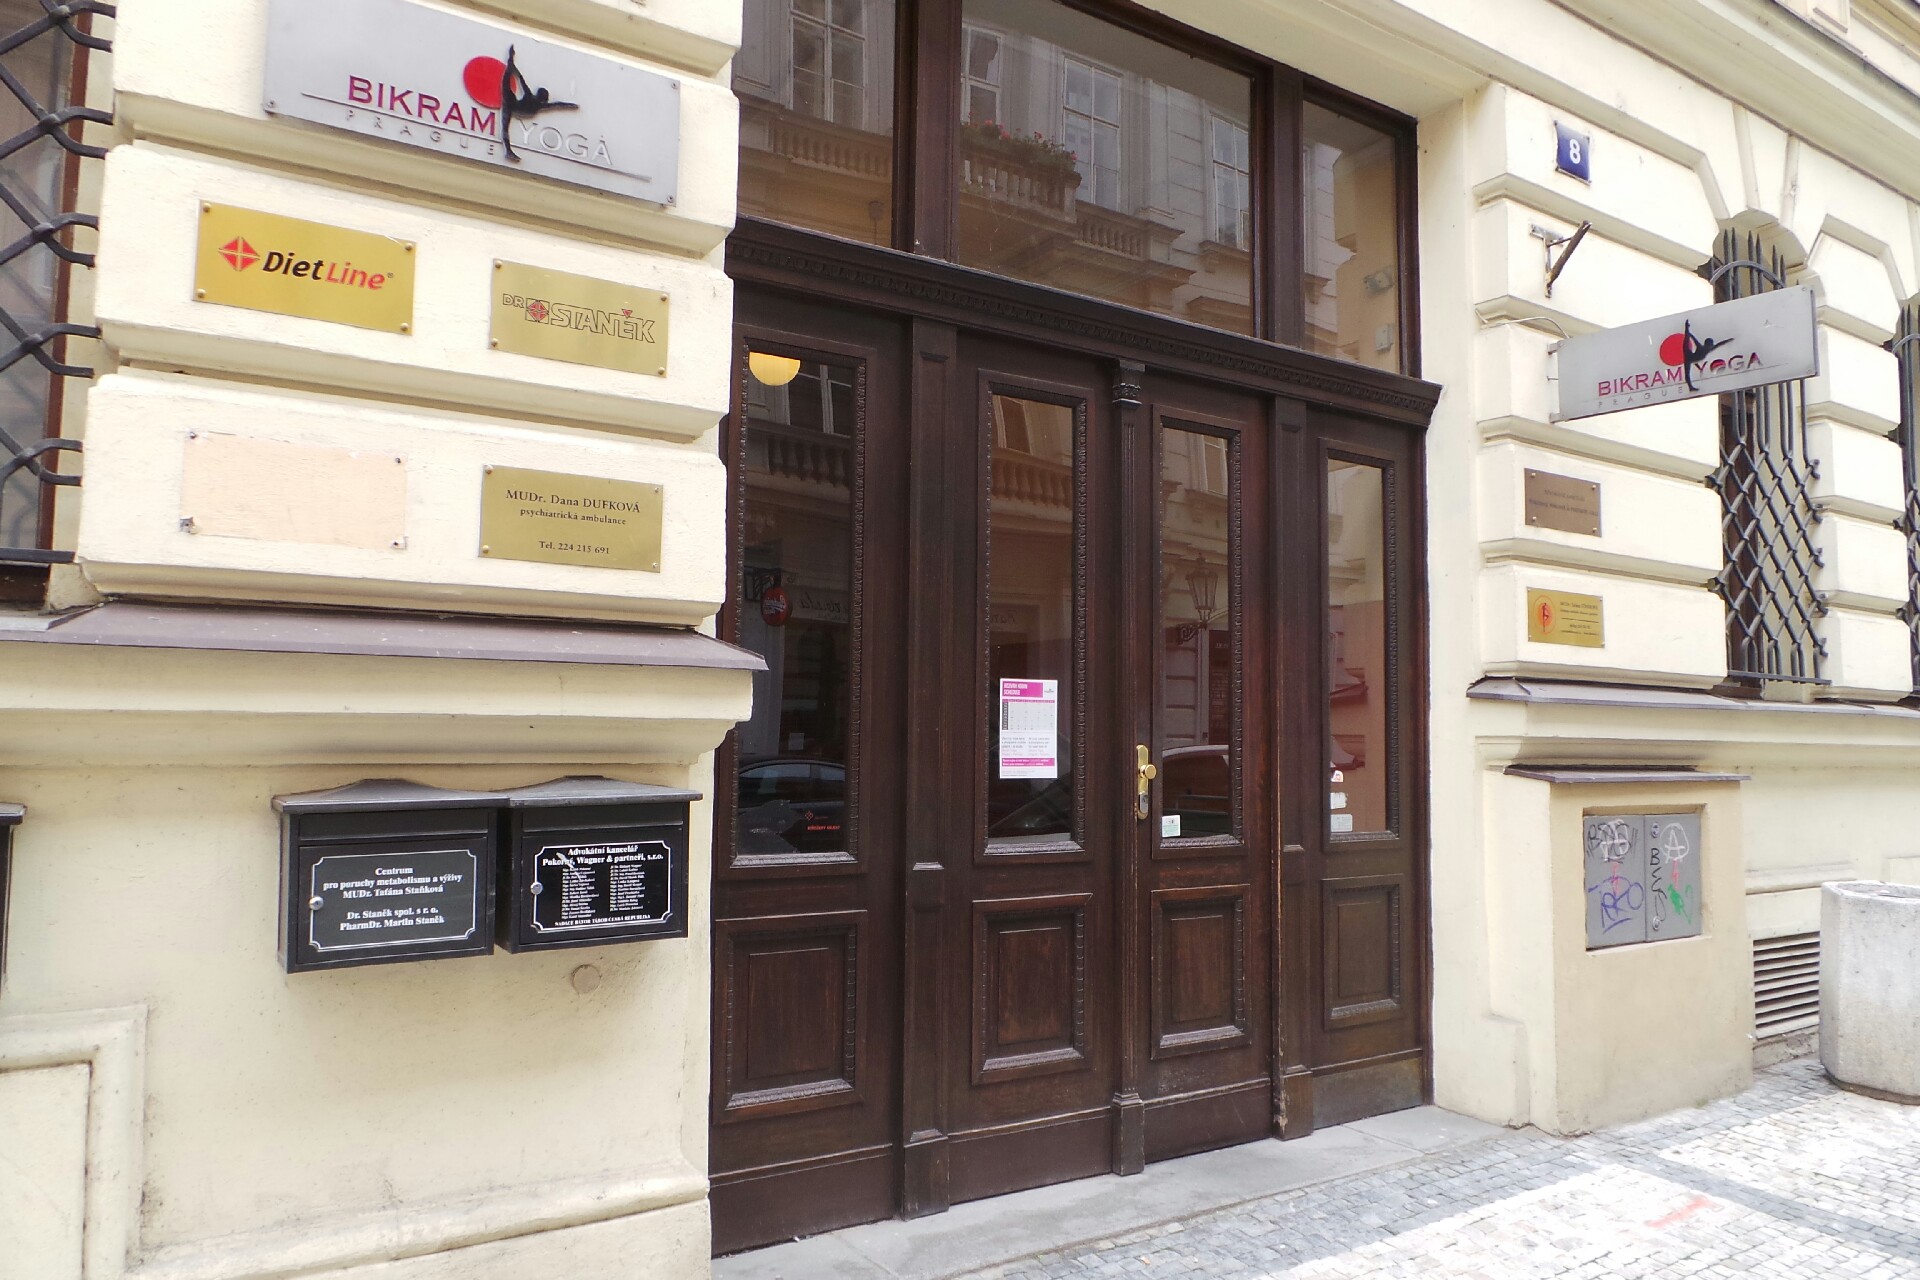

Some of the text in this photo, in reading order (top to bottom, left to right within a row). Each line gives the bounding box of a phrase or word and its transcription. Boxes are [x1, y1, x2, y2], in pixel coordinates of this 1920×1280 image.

[348, 74, 613, 166] BIKRAM YOGA
[345, 109, 495, 156] PRAGUE
[1569, 138, 1581, 164] 8
[502, 294, 525, 308] DR
[1597, 352, 1764, 397] BIKRAM YOGA
[1598, 386, 1683, 408] PRAGUE
[506, 489, 641, 513] MUDr. Dana DUFKOVÁ
[520, 508, 627, 525] psychiatrická ambulance
[539, 540, 555, 550] Tel.
[558, 543, 574, 551] 224
[577, 544, 592, 552] 215
[568, 846, 605, 856] Advokátní
[576, 856, 606, 864] Wagner
[606, 854, 614, 862] &
[375, 866, 414, 876] Centrum
[323, 882, 339, 891] pro
[340, 880, 375, 890] poruchy
[376, 876, 431, 886] metabolismu
[439, 873, 463, 884] výživy
[342, 890, 373, 899] MUDr.
[404, 884, 444, 895] Staňková
[346, 911, 361, 920] Dr.
[362, 908, 392, 919] Staněk
[394, 907, 415, 918] spol.
[340, 915, 445, 931] PharmDr. Martin Staněk
